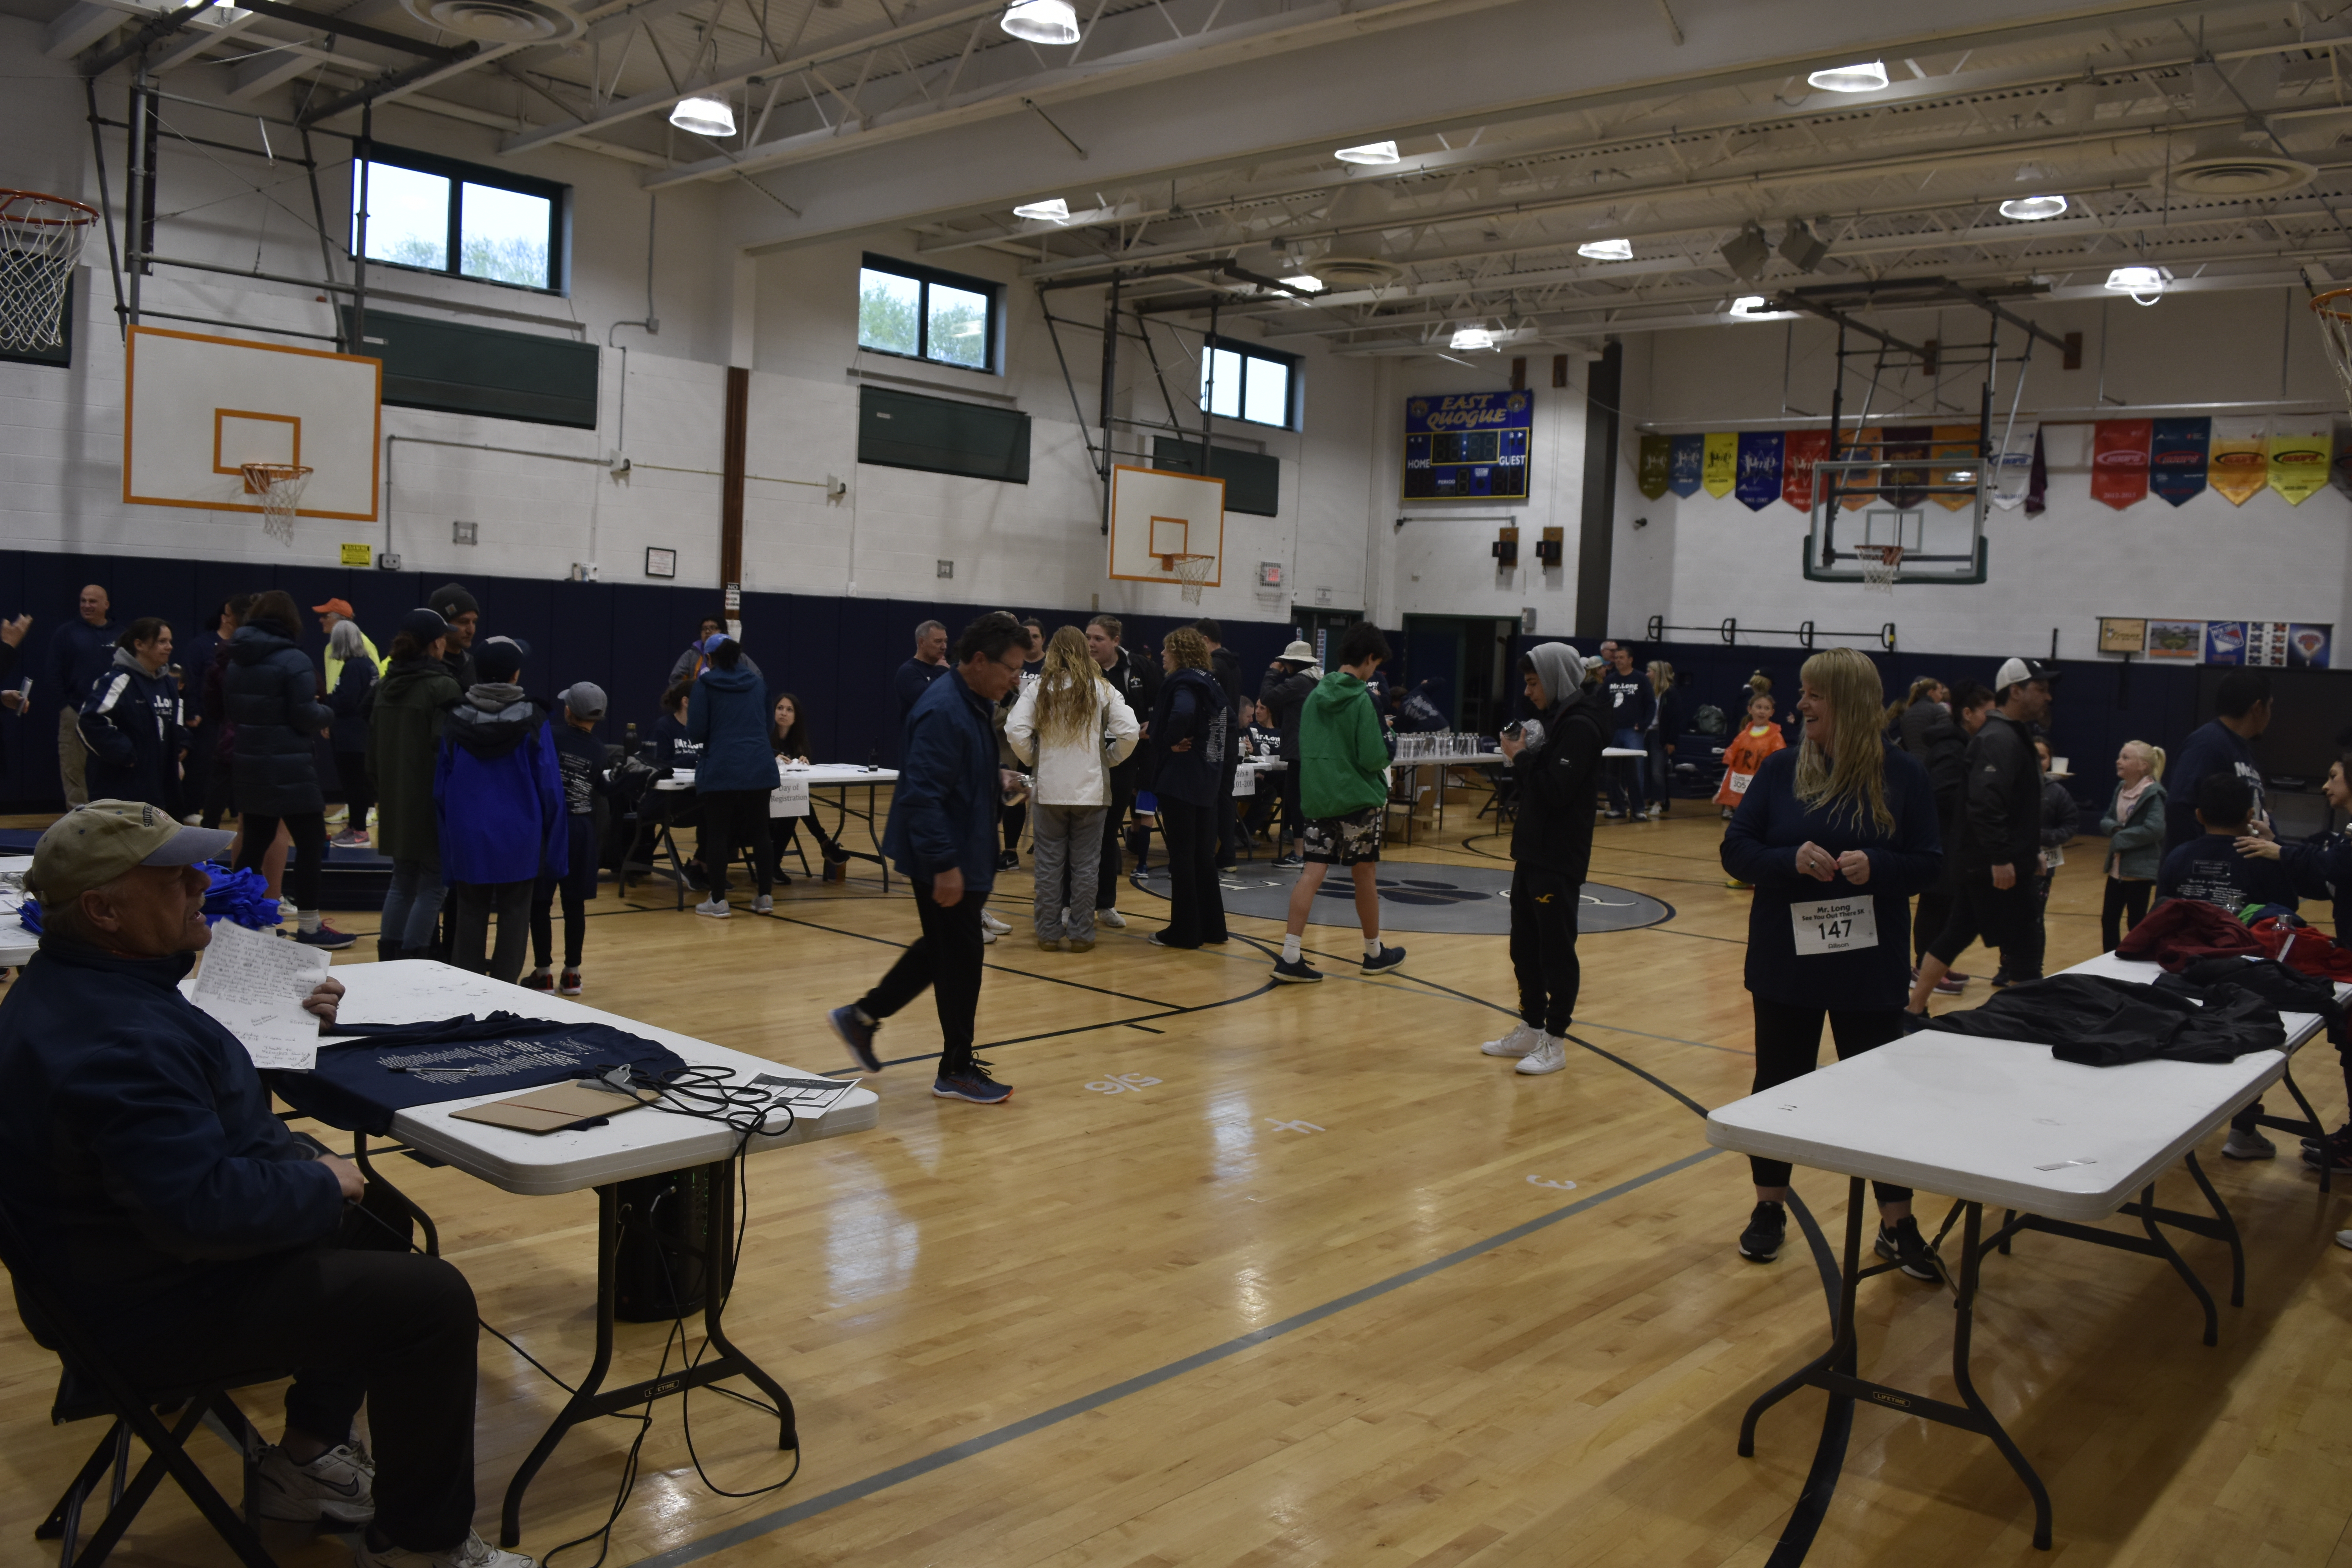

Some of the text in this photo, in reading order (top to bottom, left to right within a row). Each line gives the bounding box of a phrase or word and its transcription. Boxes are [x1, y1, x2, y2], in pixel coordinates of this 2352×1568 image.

[1441, 395, 1494, 410] EAST
[1427, 408, 1507, 431] QUOGUE
[1408, 459, 1430, 469] HOME
[1499, 455, 1526, 466] GUEST
[771, 794, 807, 803] Registration
[143, 804, 153, 827] SOUTH
[1818, 919, 1852, 940] 147
[649, 1382, 675, 1395] LETIME
[1877, 1394, 1906, 1405] LIFETIME
